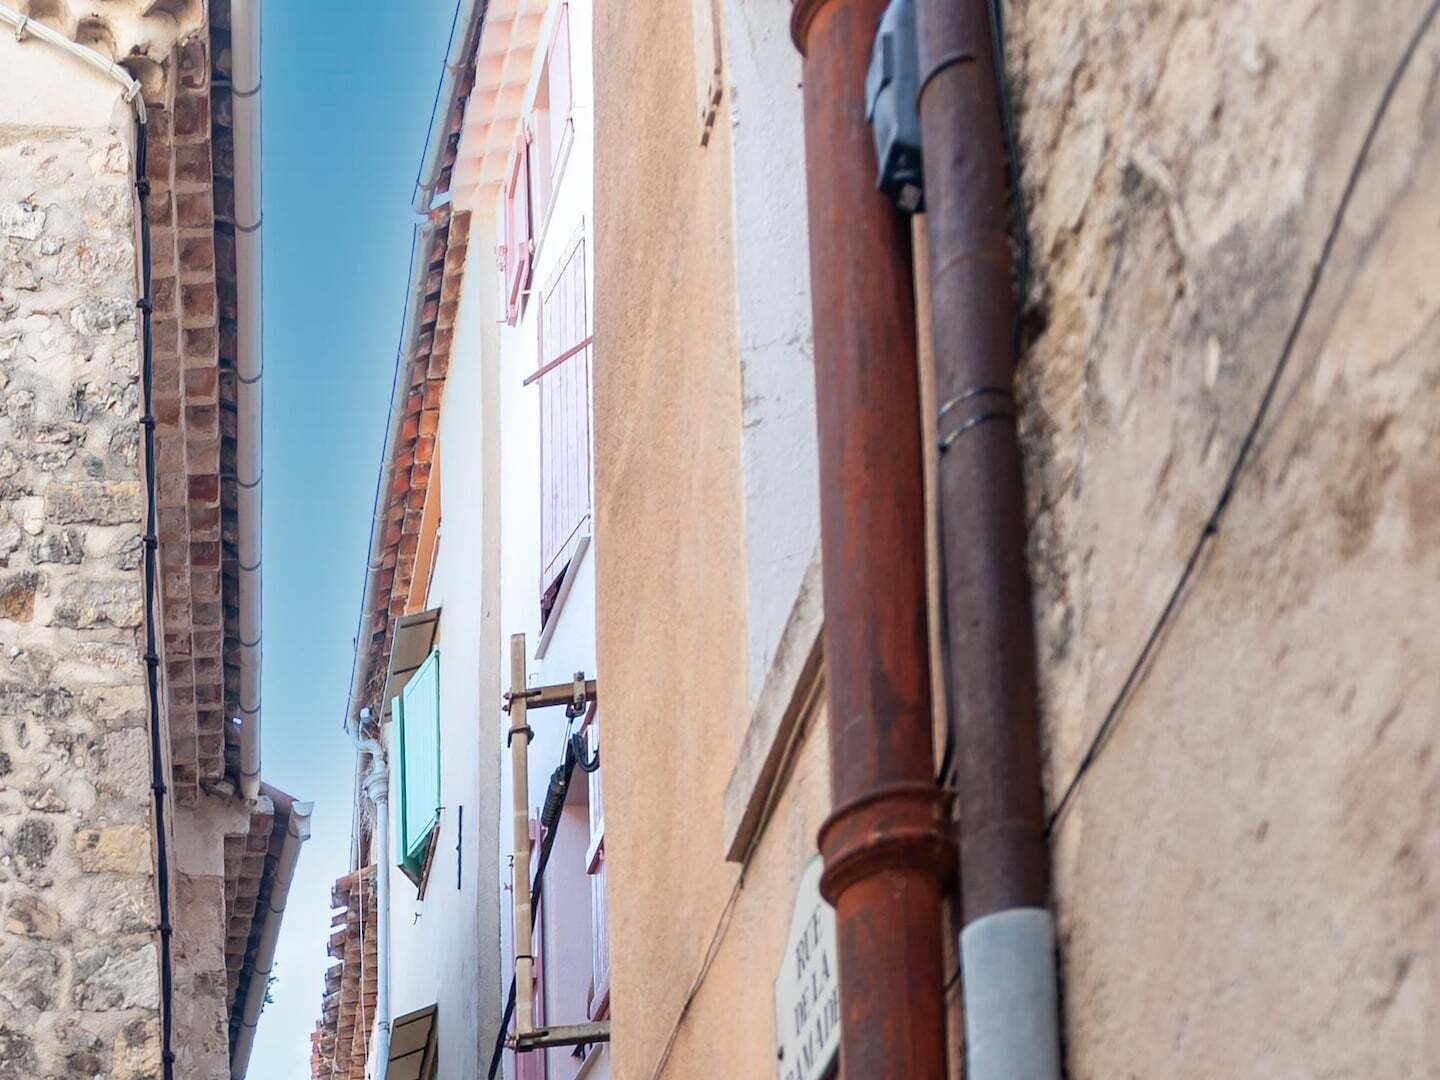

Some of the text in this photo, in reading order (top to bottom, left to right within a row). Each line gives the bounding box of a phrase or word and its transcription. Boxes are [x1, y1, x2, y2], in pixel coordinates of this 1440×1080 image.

[794, 904, 822, 980] RUE
[793, 948, 830, 1037] DE LA
